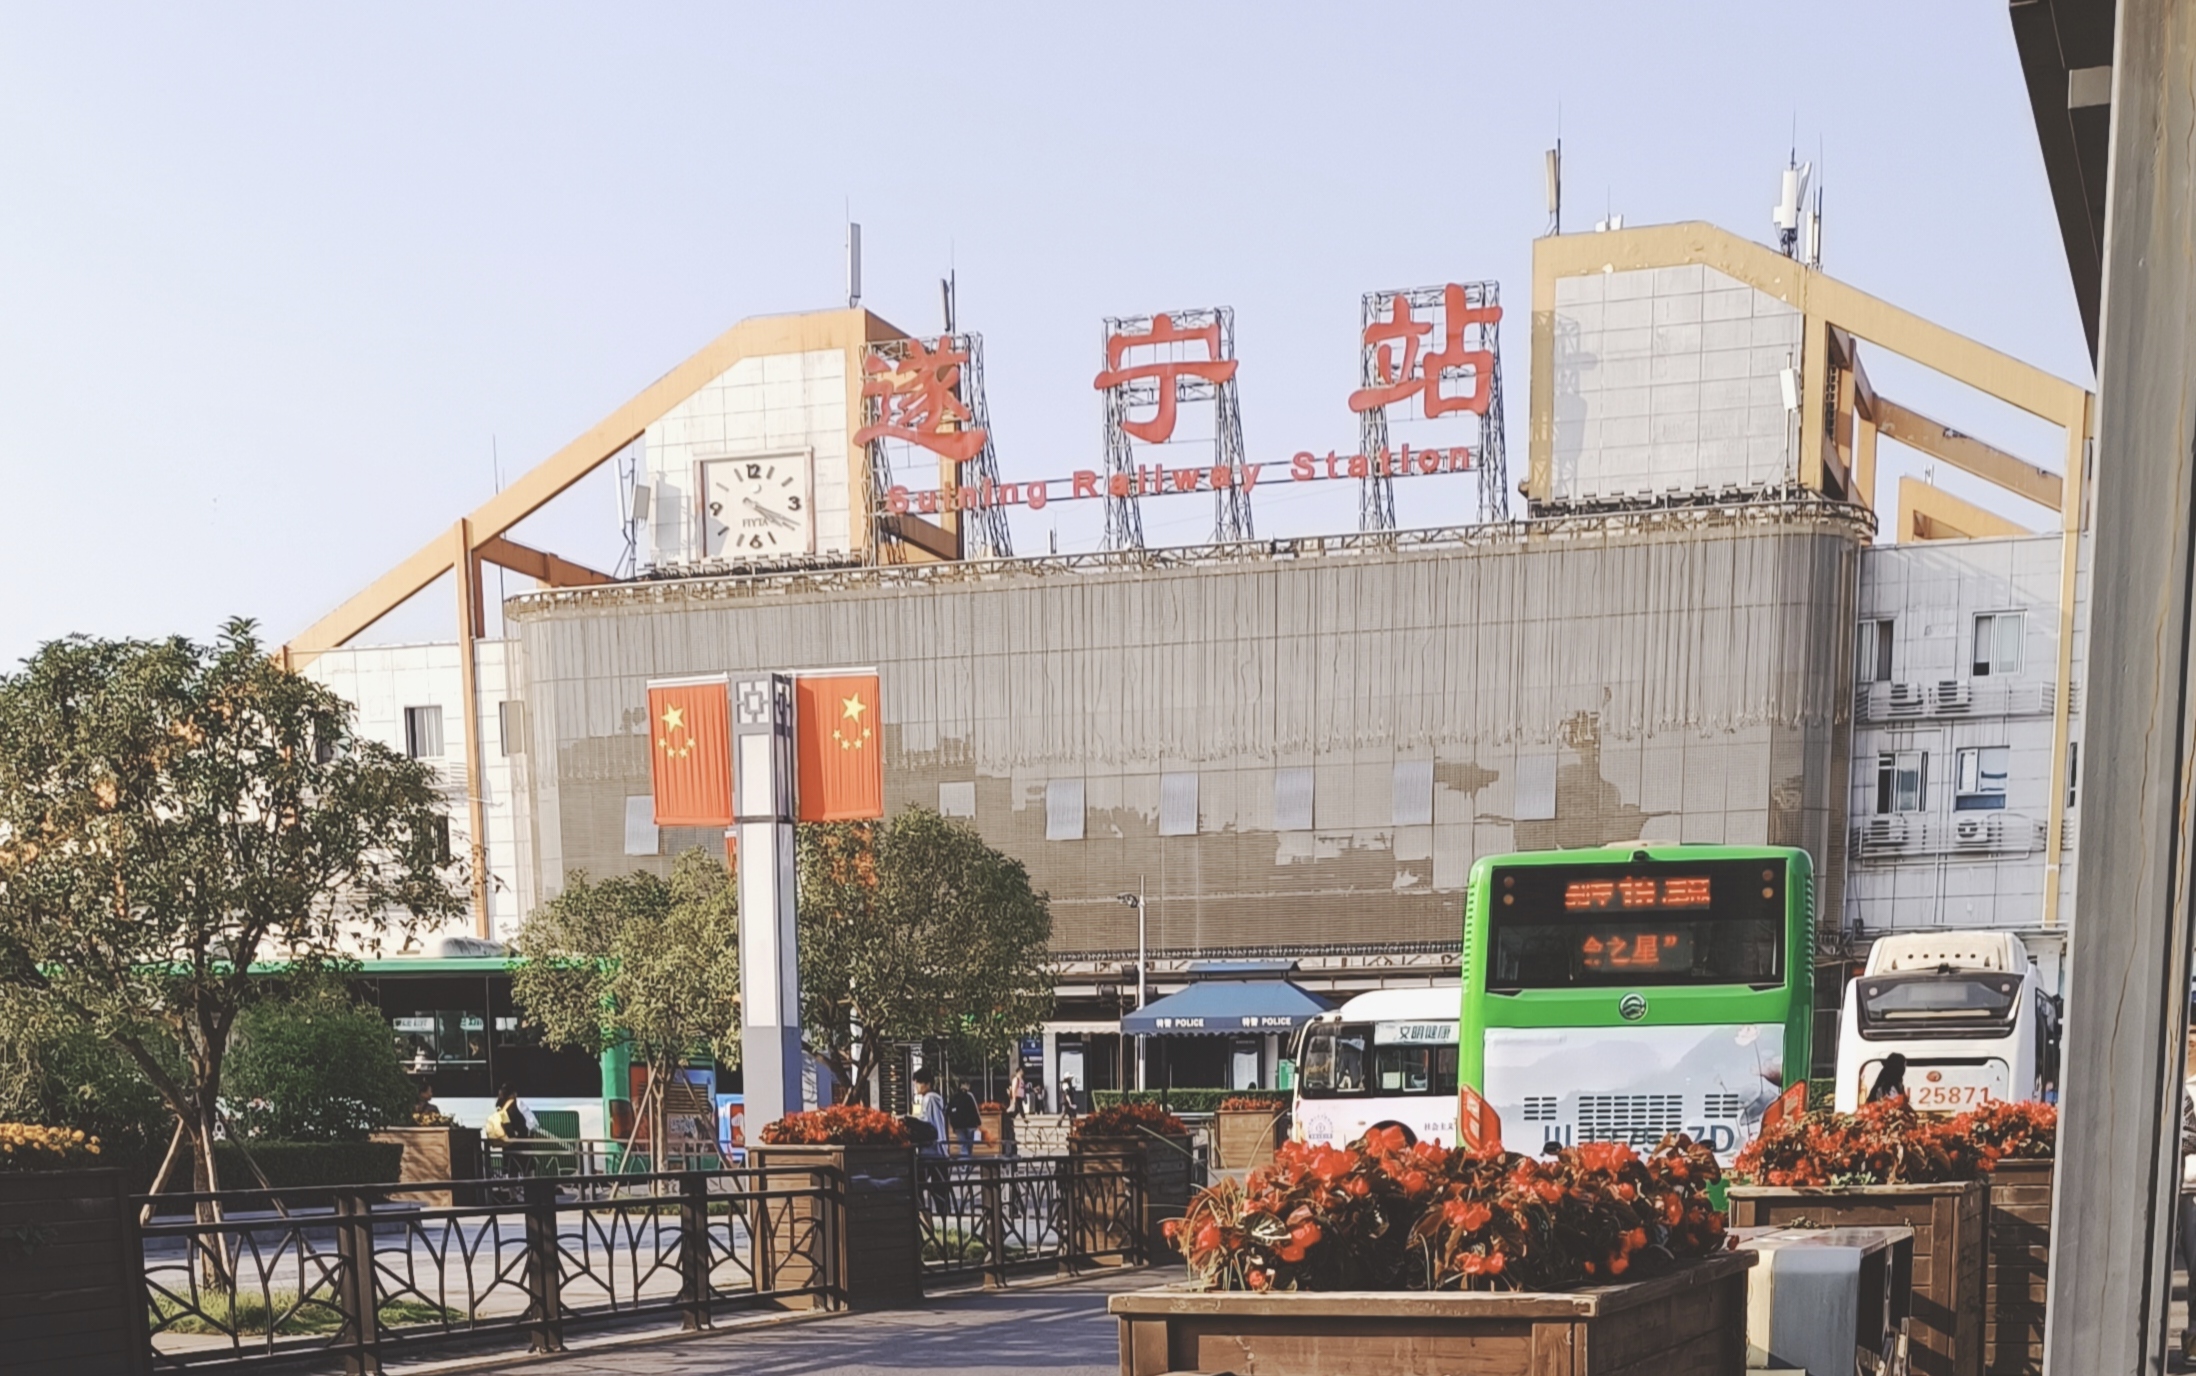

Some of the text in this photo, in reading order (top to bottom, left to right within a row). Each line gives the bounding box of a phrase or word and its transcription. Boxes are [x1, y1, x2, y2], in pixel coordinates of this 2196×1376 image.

[853, 282, 1503, 461] 遂宁站
[746, 463, 762, 479] 12
[887, 442, 1471, 514] Suining Railway Station
[709, 501, 723, 516] 9
[788, 495, 802, 511] 3
[749, 534, 763, 549] 6
[1175, 1018, 1205, 1028] POLICE
[1261, 1016, 1292, 1026] POLICE
